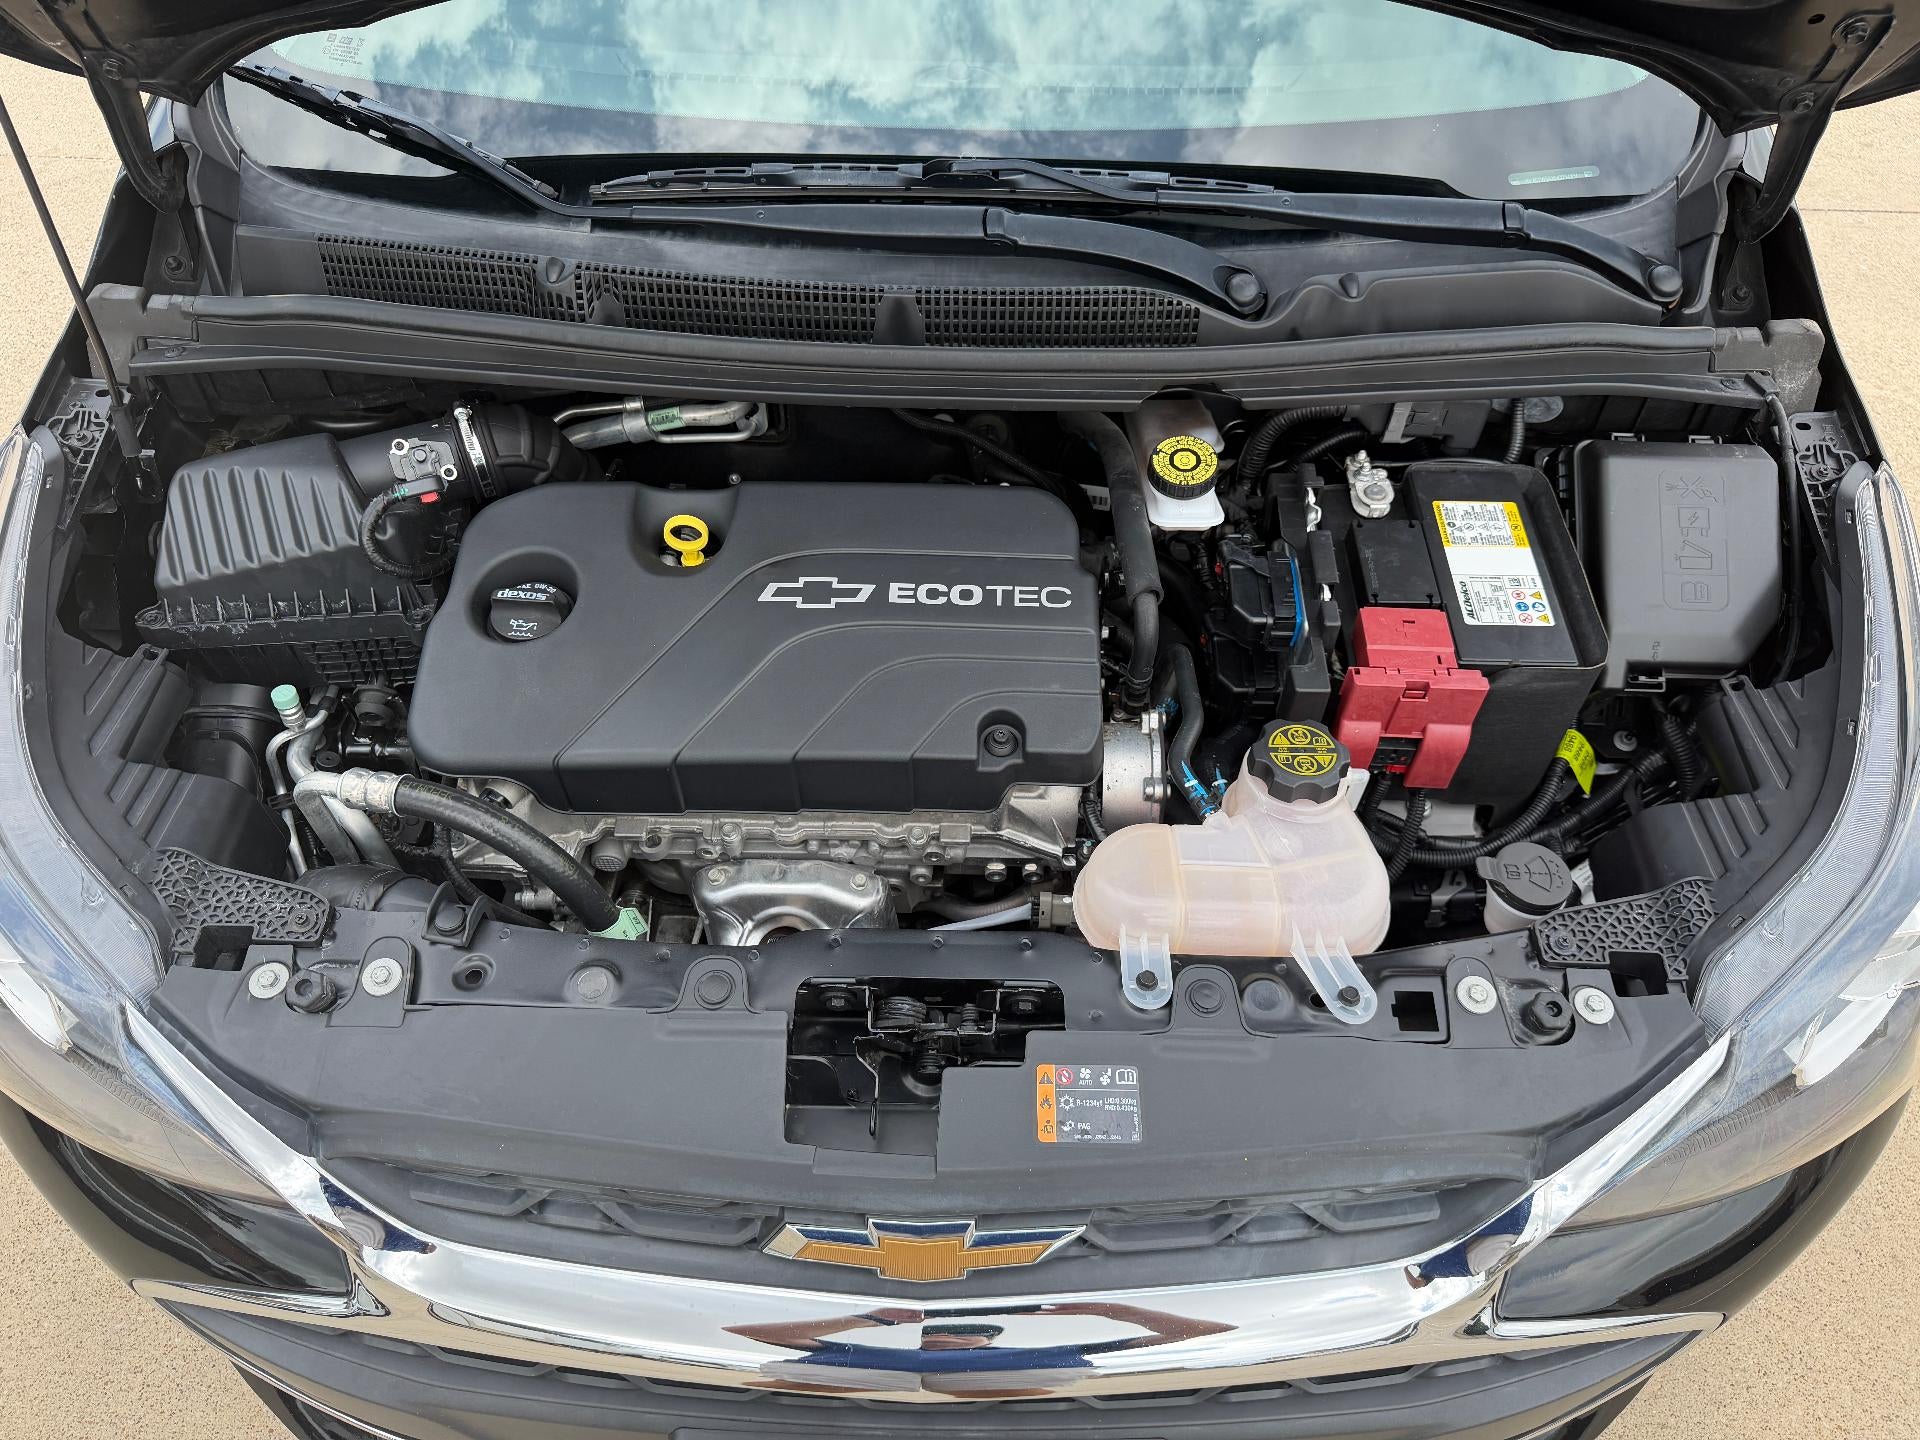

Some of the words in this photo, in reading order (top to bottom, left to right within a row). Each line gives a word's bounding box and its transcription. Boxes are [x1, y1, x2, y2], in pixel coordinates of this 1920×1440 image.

[496, 588, 550, 601] dexos
[888, 582, 1073, 609] ECOTEC
[1460, 581, 1477, 620] ACDelco
[1077, 1122, 1091, 1130] PAG
